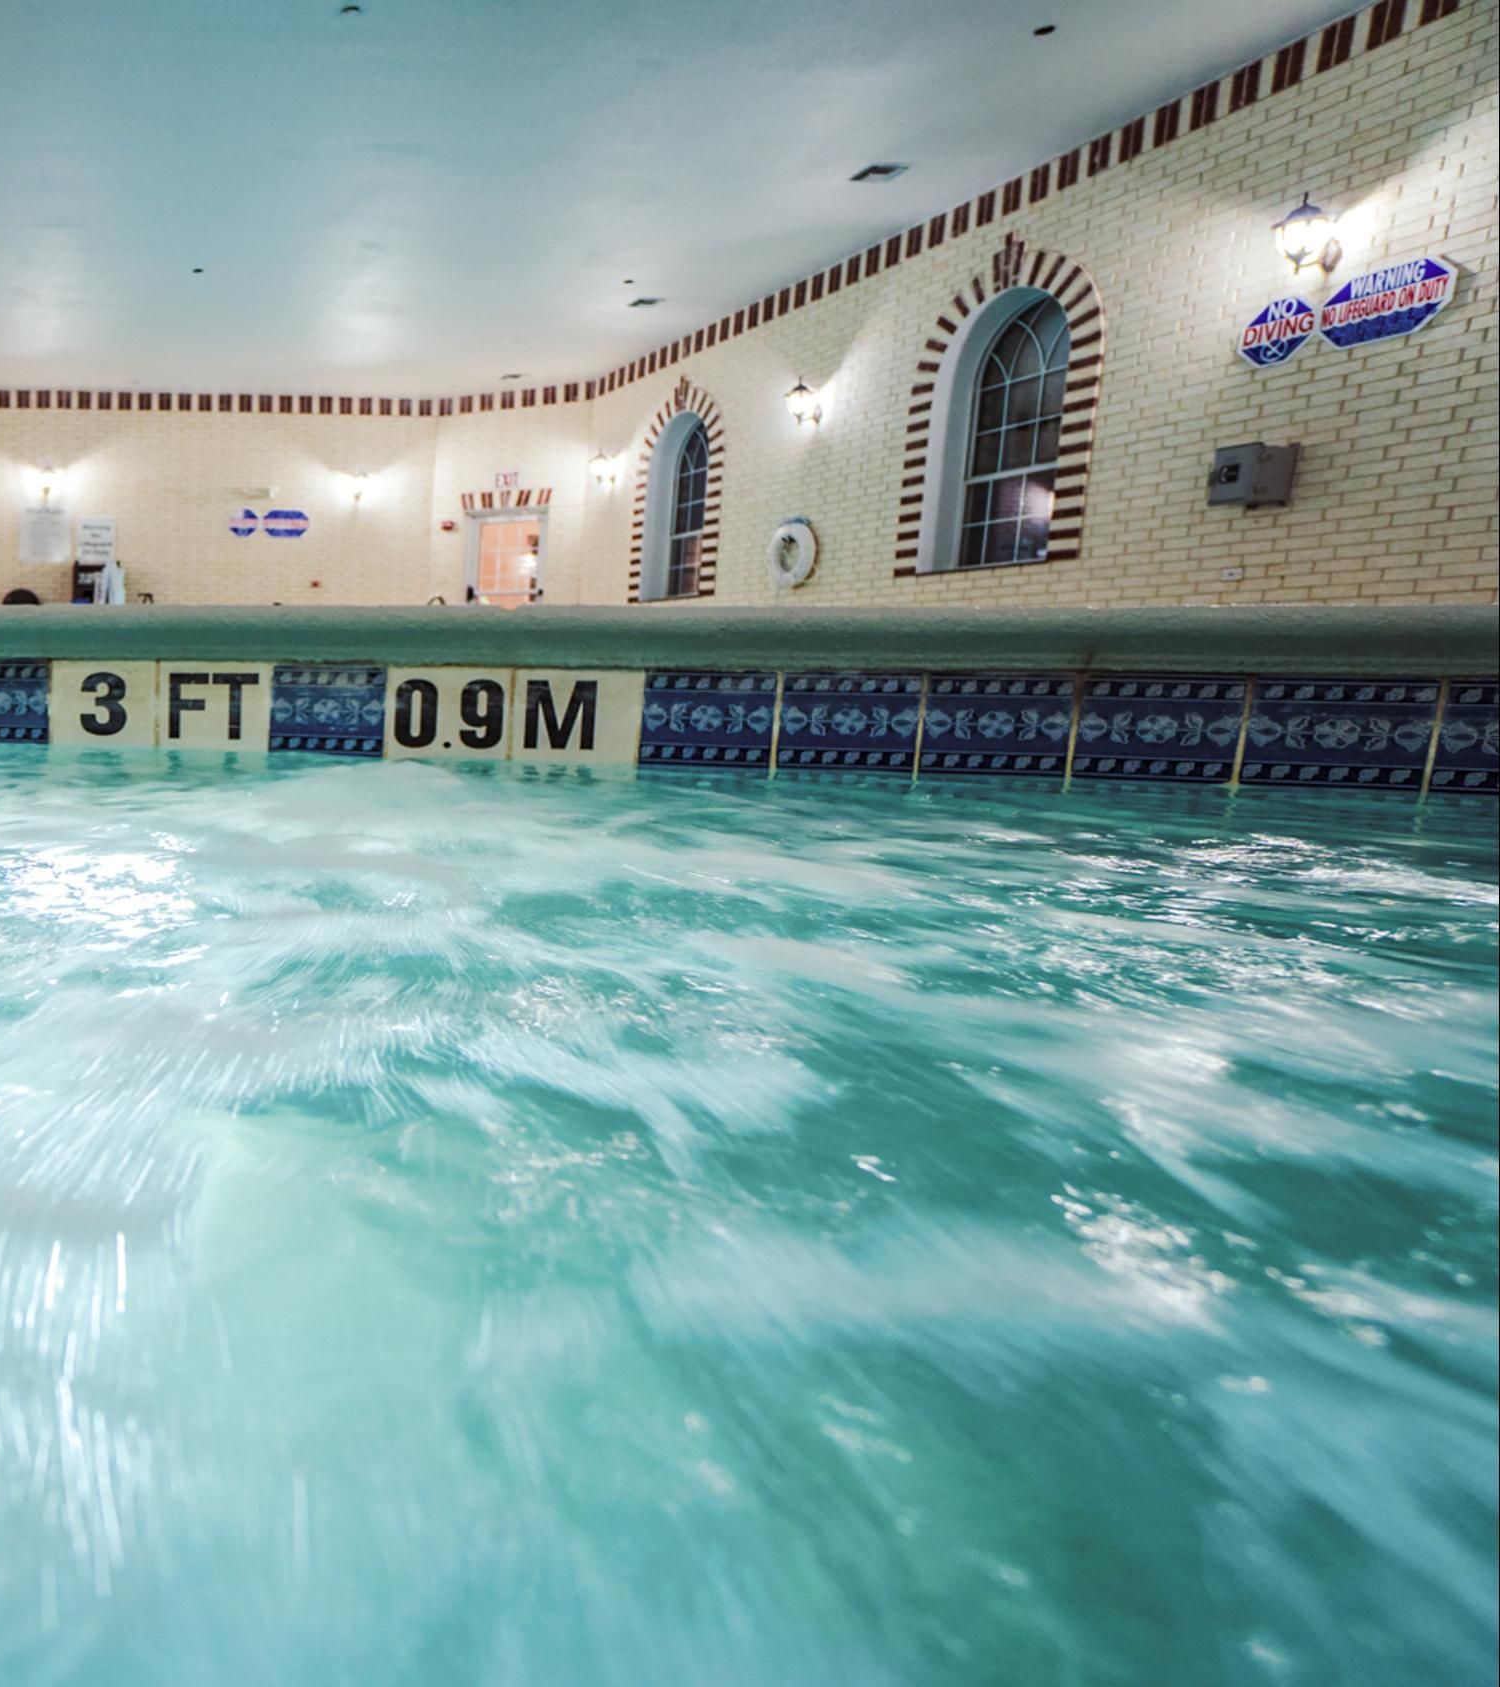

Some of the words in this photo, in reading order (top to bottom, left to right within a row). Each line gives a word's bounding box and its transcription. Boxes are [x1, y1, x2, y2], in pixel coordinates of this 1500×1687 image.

[1351, 260, 1426, 299] WARNING
[1267, 298, 1298, 323] NO
[1321, 306, 1337, 327] NO
[1338, 291, 1396, 323] LIFEGUARD
[1399, 287, 1415, 307] ON
[1418, 275, 1449, 302] DUTY
[1243, 312, 1315, 347] DIVING
[495, 472, 519, 487] EXIT
[80, 672, 127, 736] 3
[168, 672, 260, 740] FT
